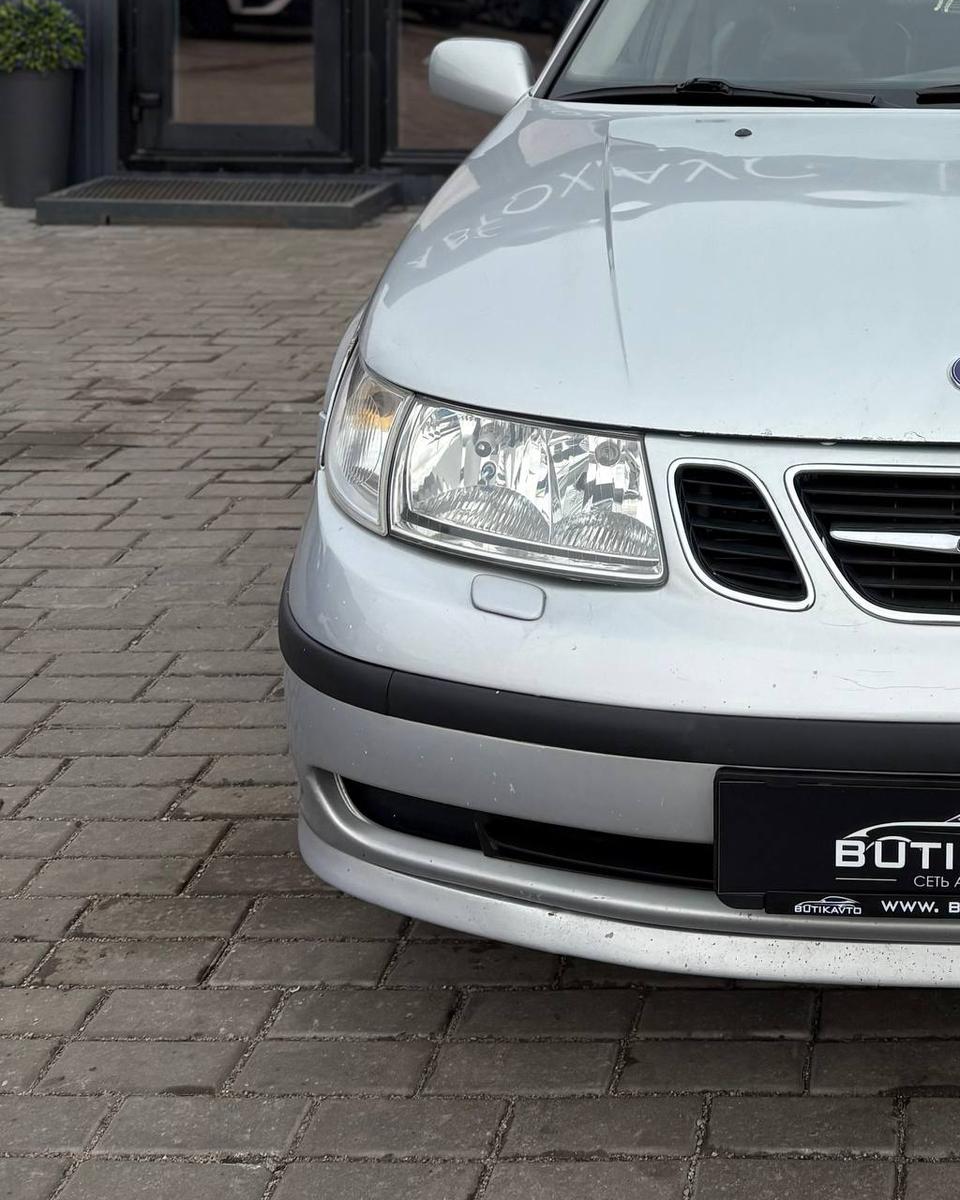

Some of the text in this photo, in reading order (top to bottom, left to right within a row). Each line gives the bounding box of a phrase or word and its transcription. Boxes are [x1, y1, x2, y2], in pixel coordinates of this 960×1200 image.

[913, 875, 949, 888] СЕТЬ
[794, 905, 862, 915] BUTIKAVTO
[881, 900, 939, 913] WWW.
